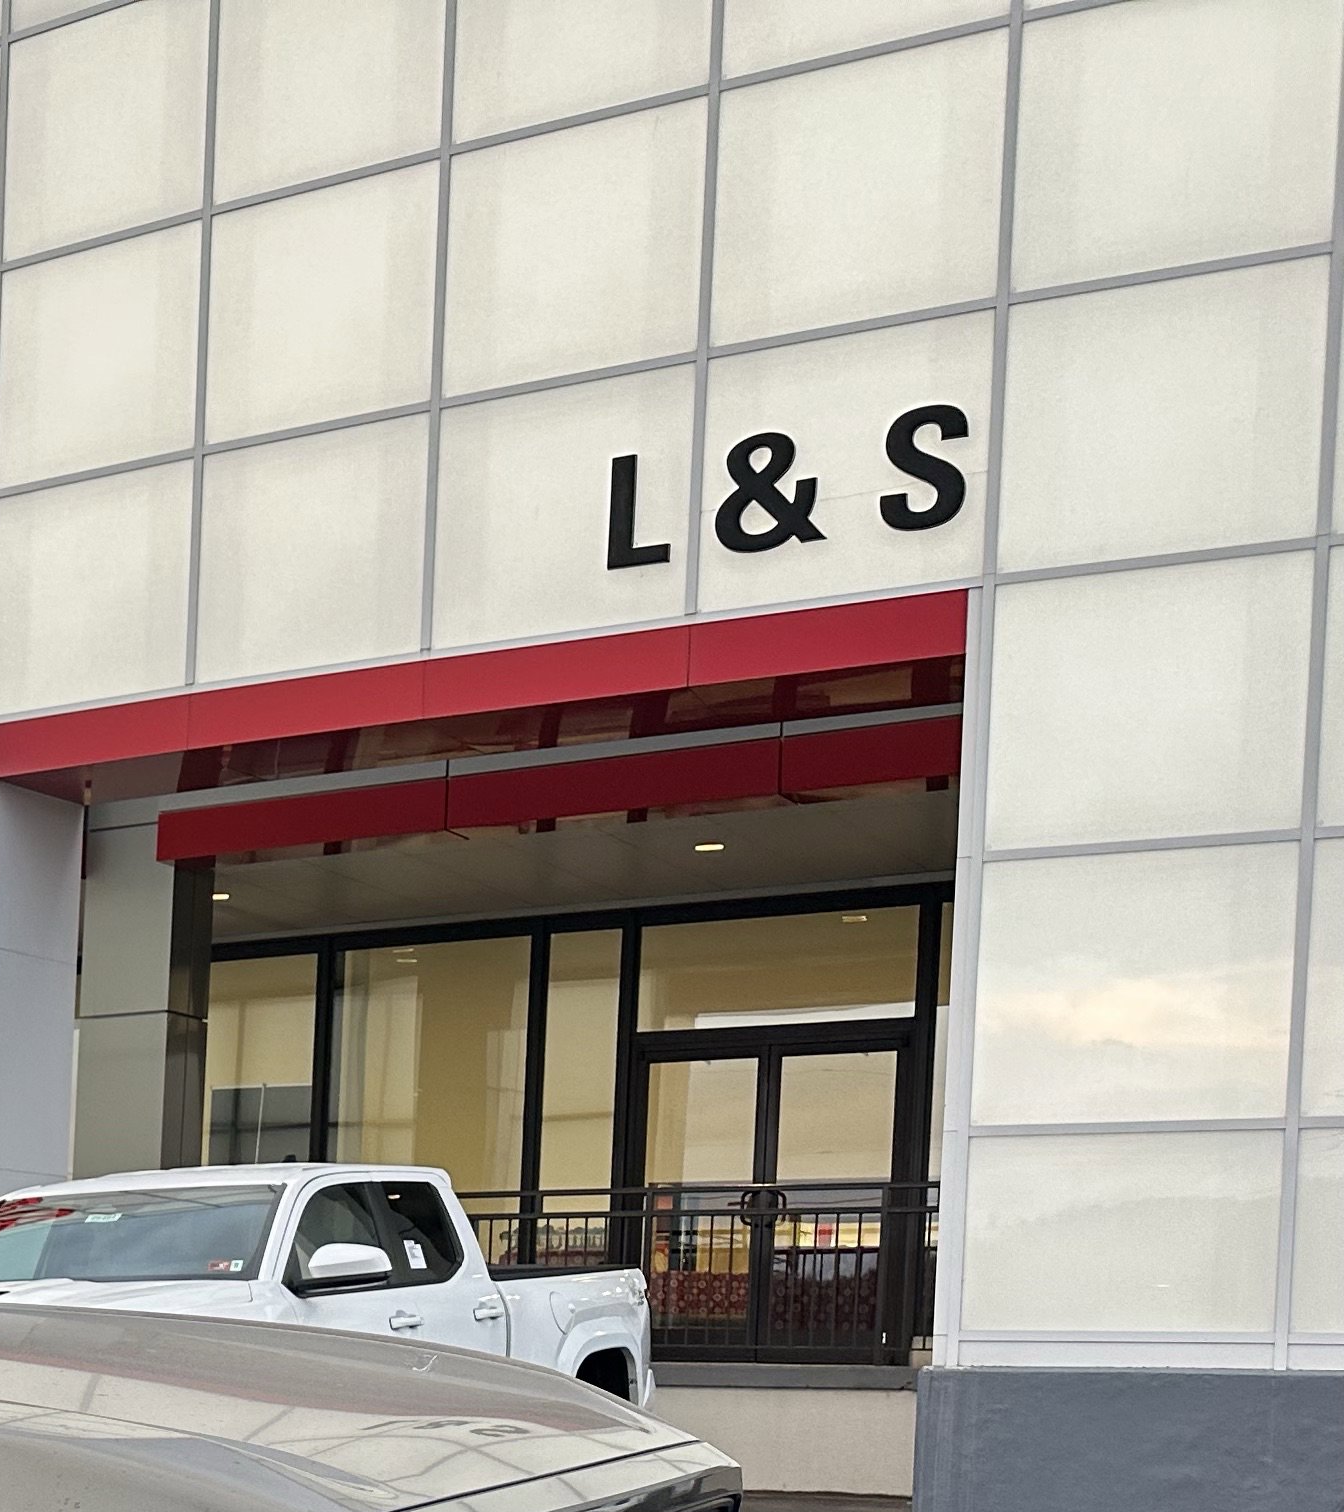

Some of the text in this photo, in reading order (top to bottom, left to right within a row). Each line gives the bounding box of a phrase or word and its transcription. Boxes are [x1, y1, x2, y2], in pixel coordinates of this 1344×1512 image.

[607, 404, 969, 570] L & S
